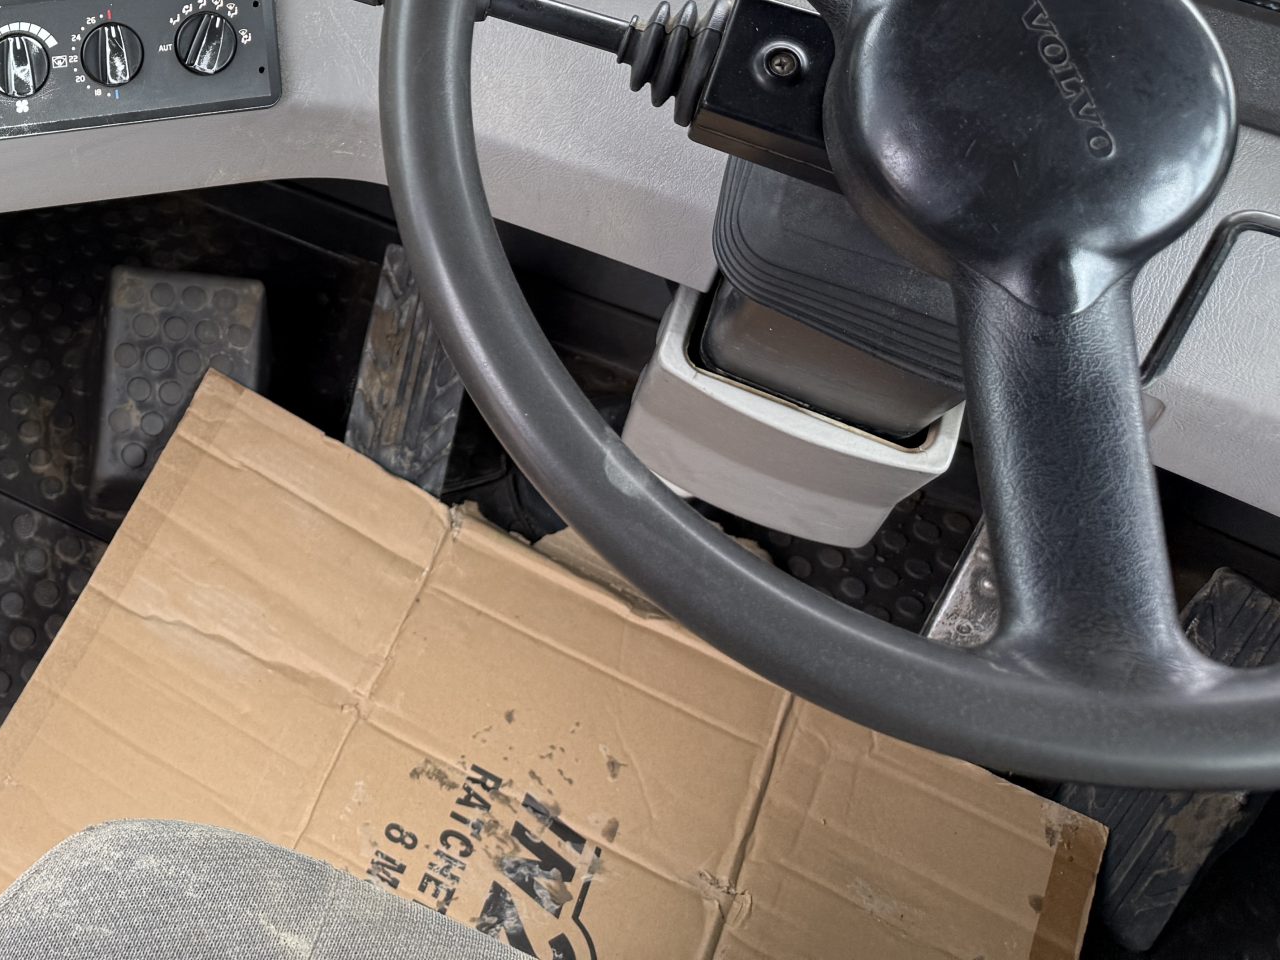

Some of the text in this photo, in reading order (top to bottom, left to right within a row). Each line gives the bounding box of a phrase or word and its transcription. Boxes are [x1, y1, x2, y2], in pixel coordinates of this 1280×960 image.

[72, 34, 81, 42] 24
[75, 75, 85, 83] 20
[384, 823, 418, 850] 8
[413, 764, 503, 916] RATCHE
